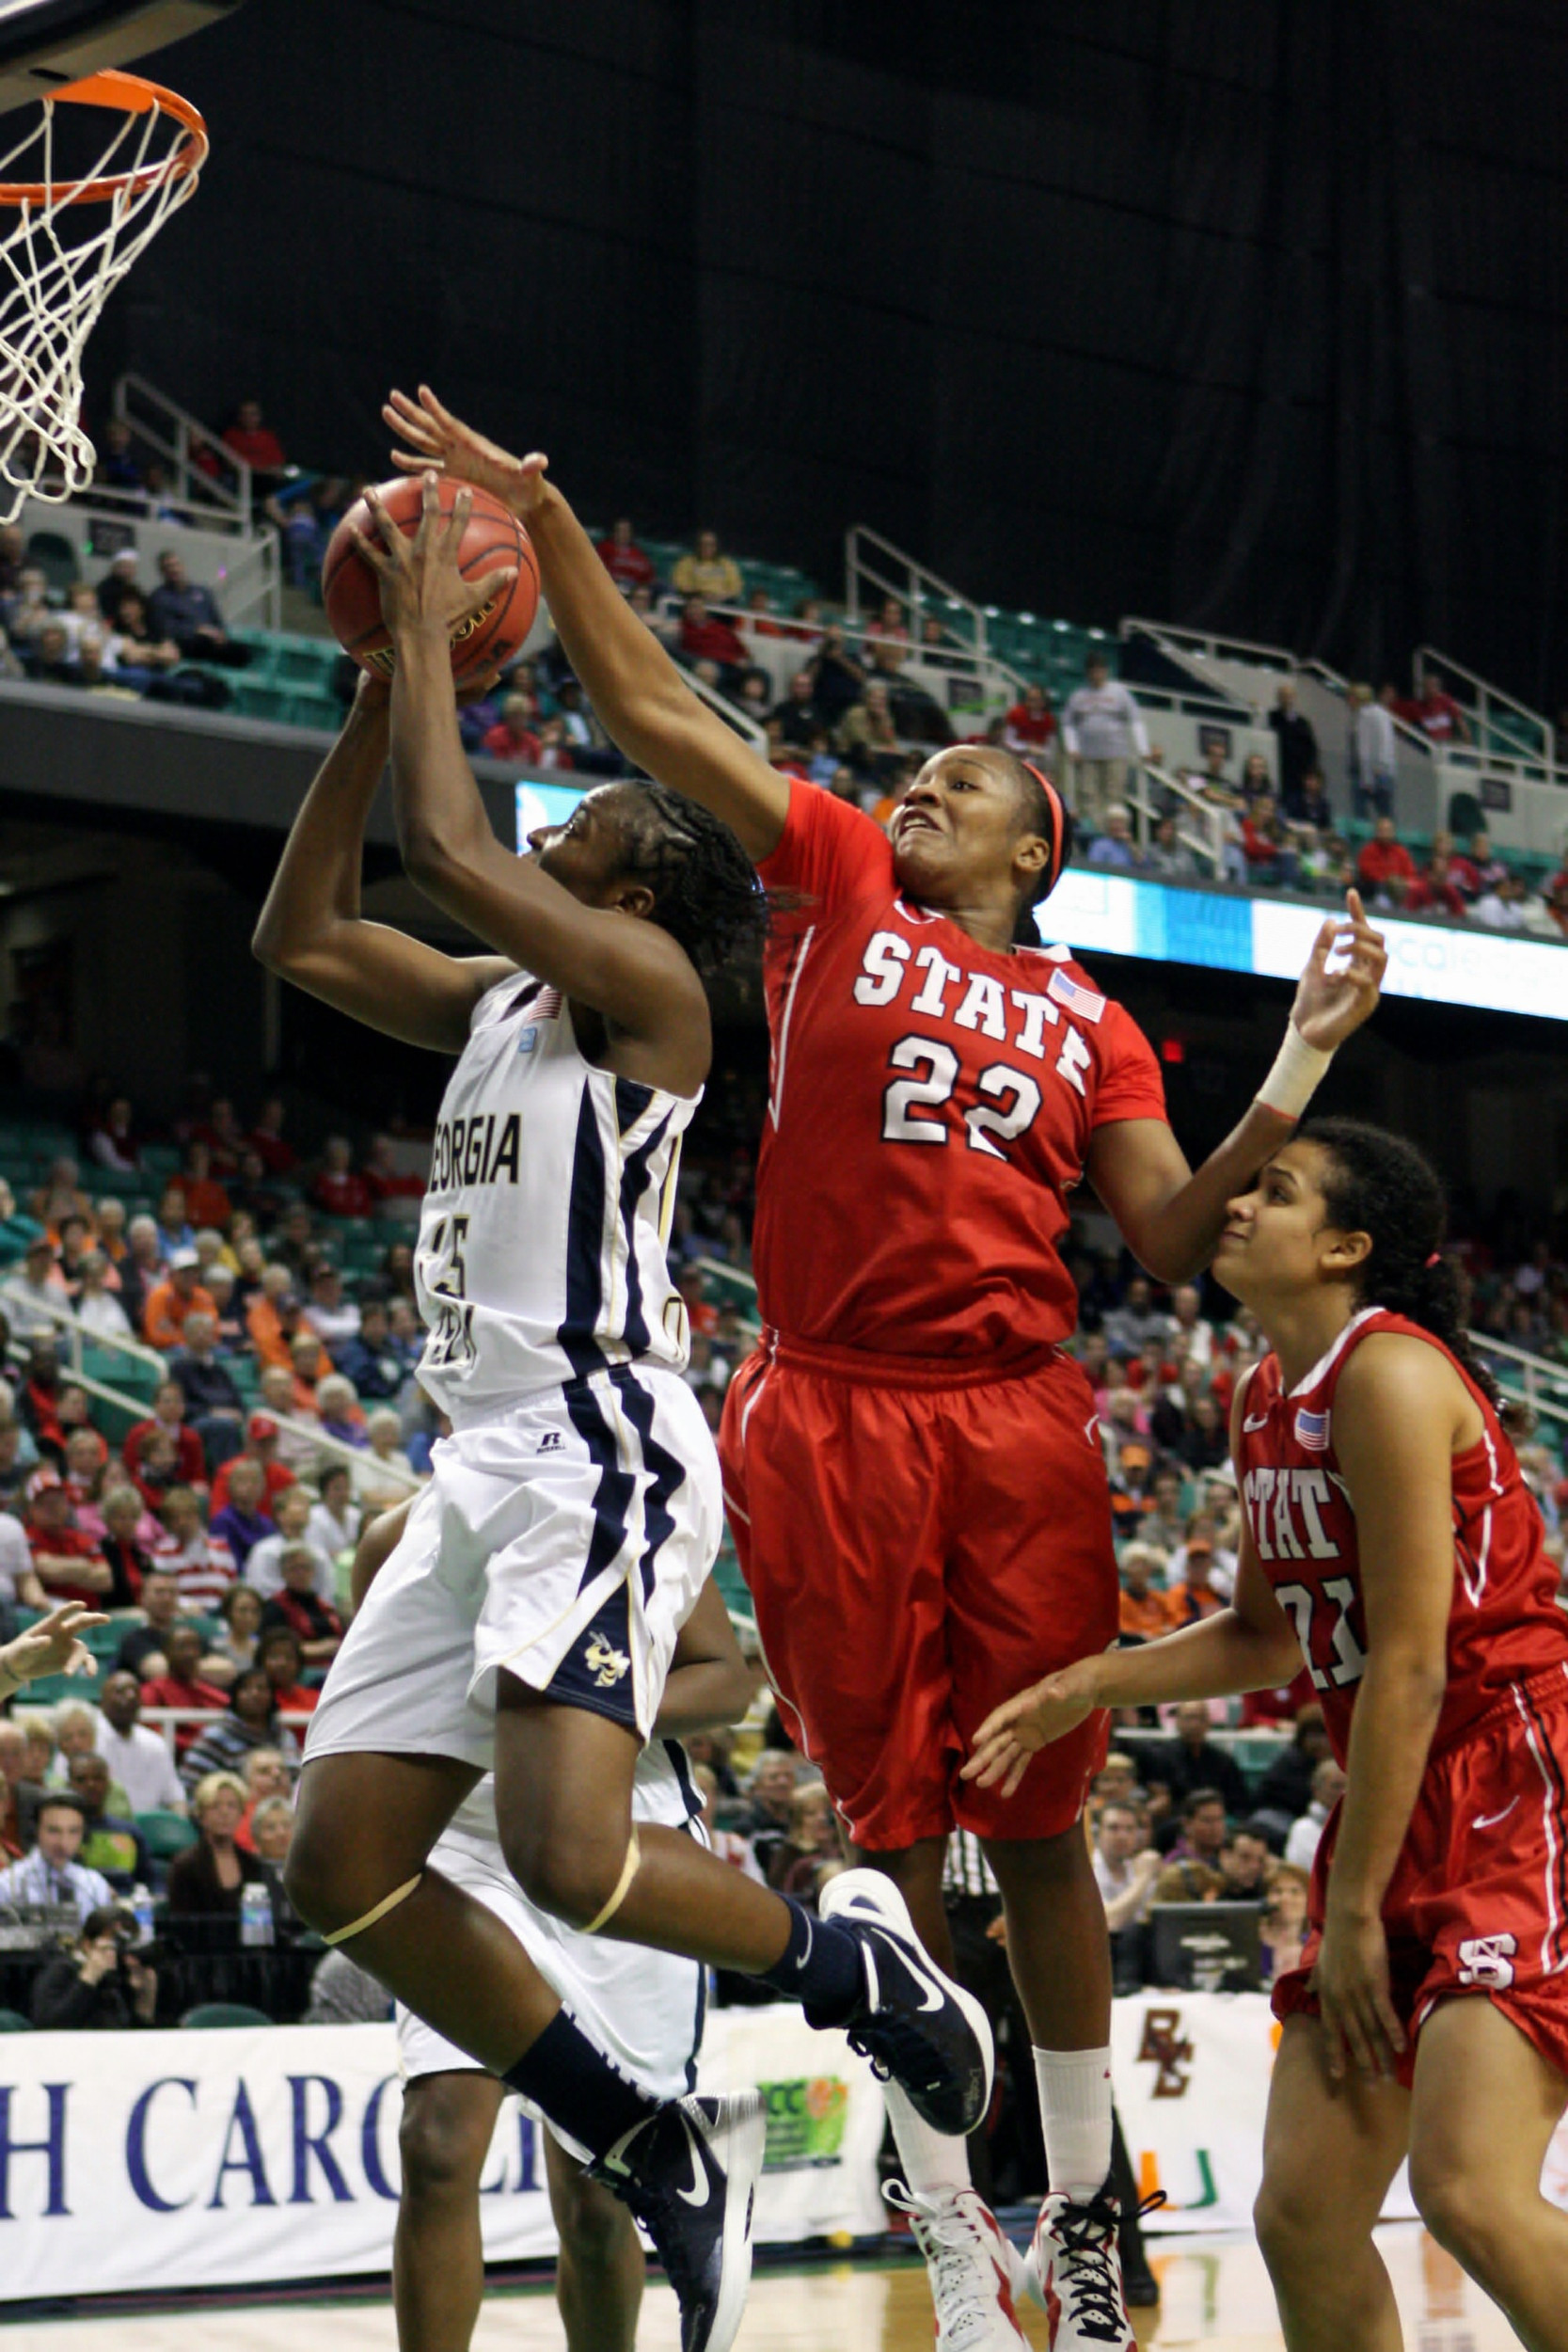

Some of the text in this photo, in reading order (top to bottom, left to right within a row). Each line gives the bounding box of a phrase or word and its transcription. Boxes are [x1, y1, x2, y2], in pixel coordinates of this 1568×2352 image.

[853, 930, 1093, 1098] STATE
[880, 1033, 1041, 1161] 22
[429, 1113, 521, 1192] EORGIA
[1243, 1468, 1353, 1560] TAT
[760, 2081, 806, 2116] CC
